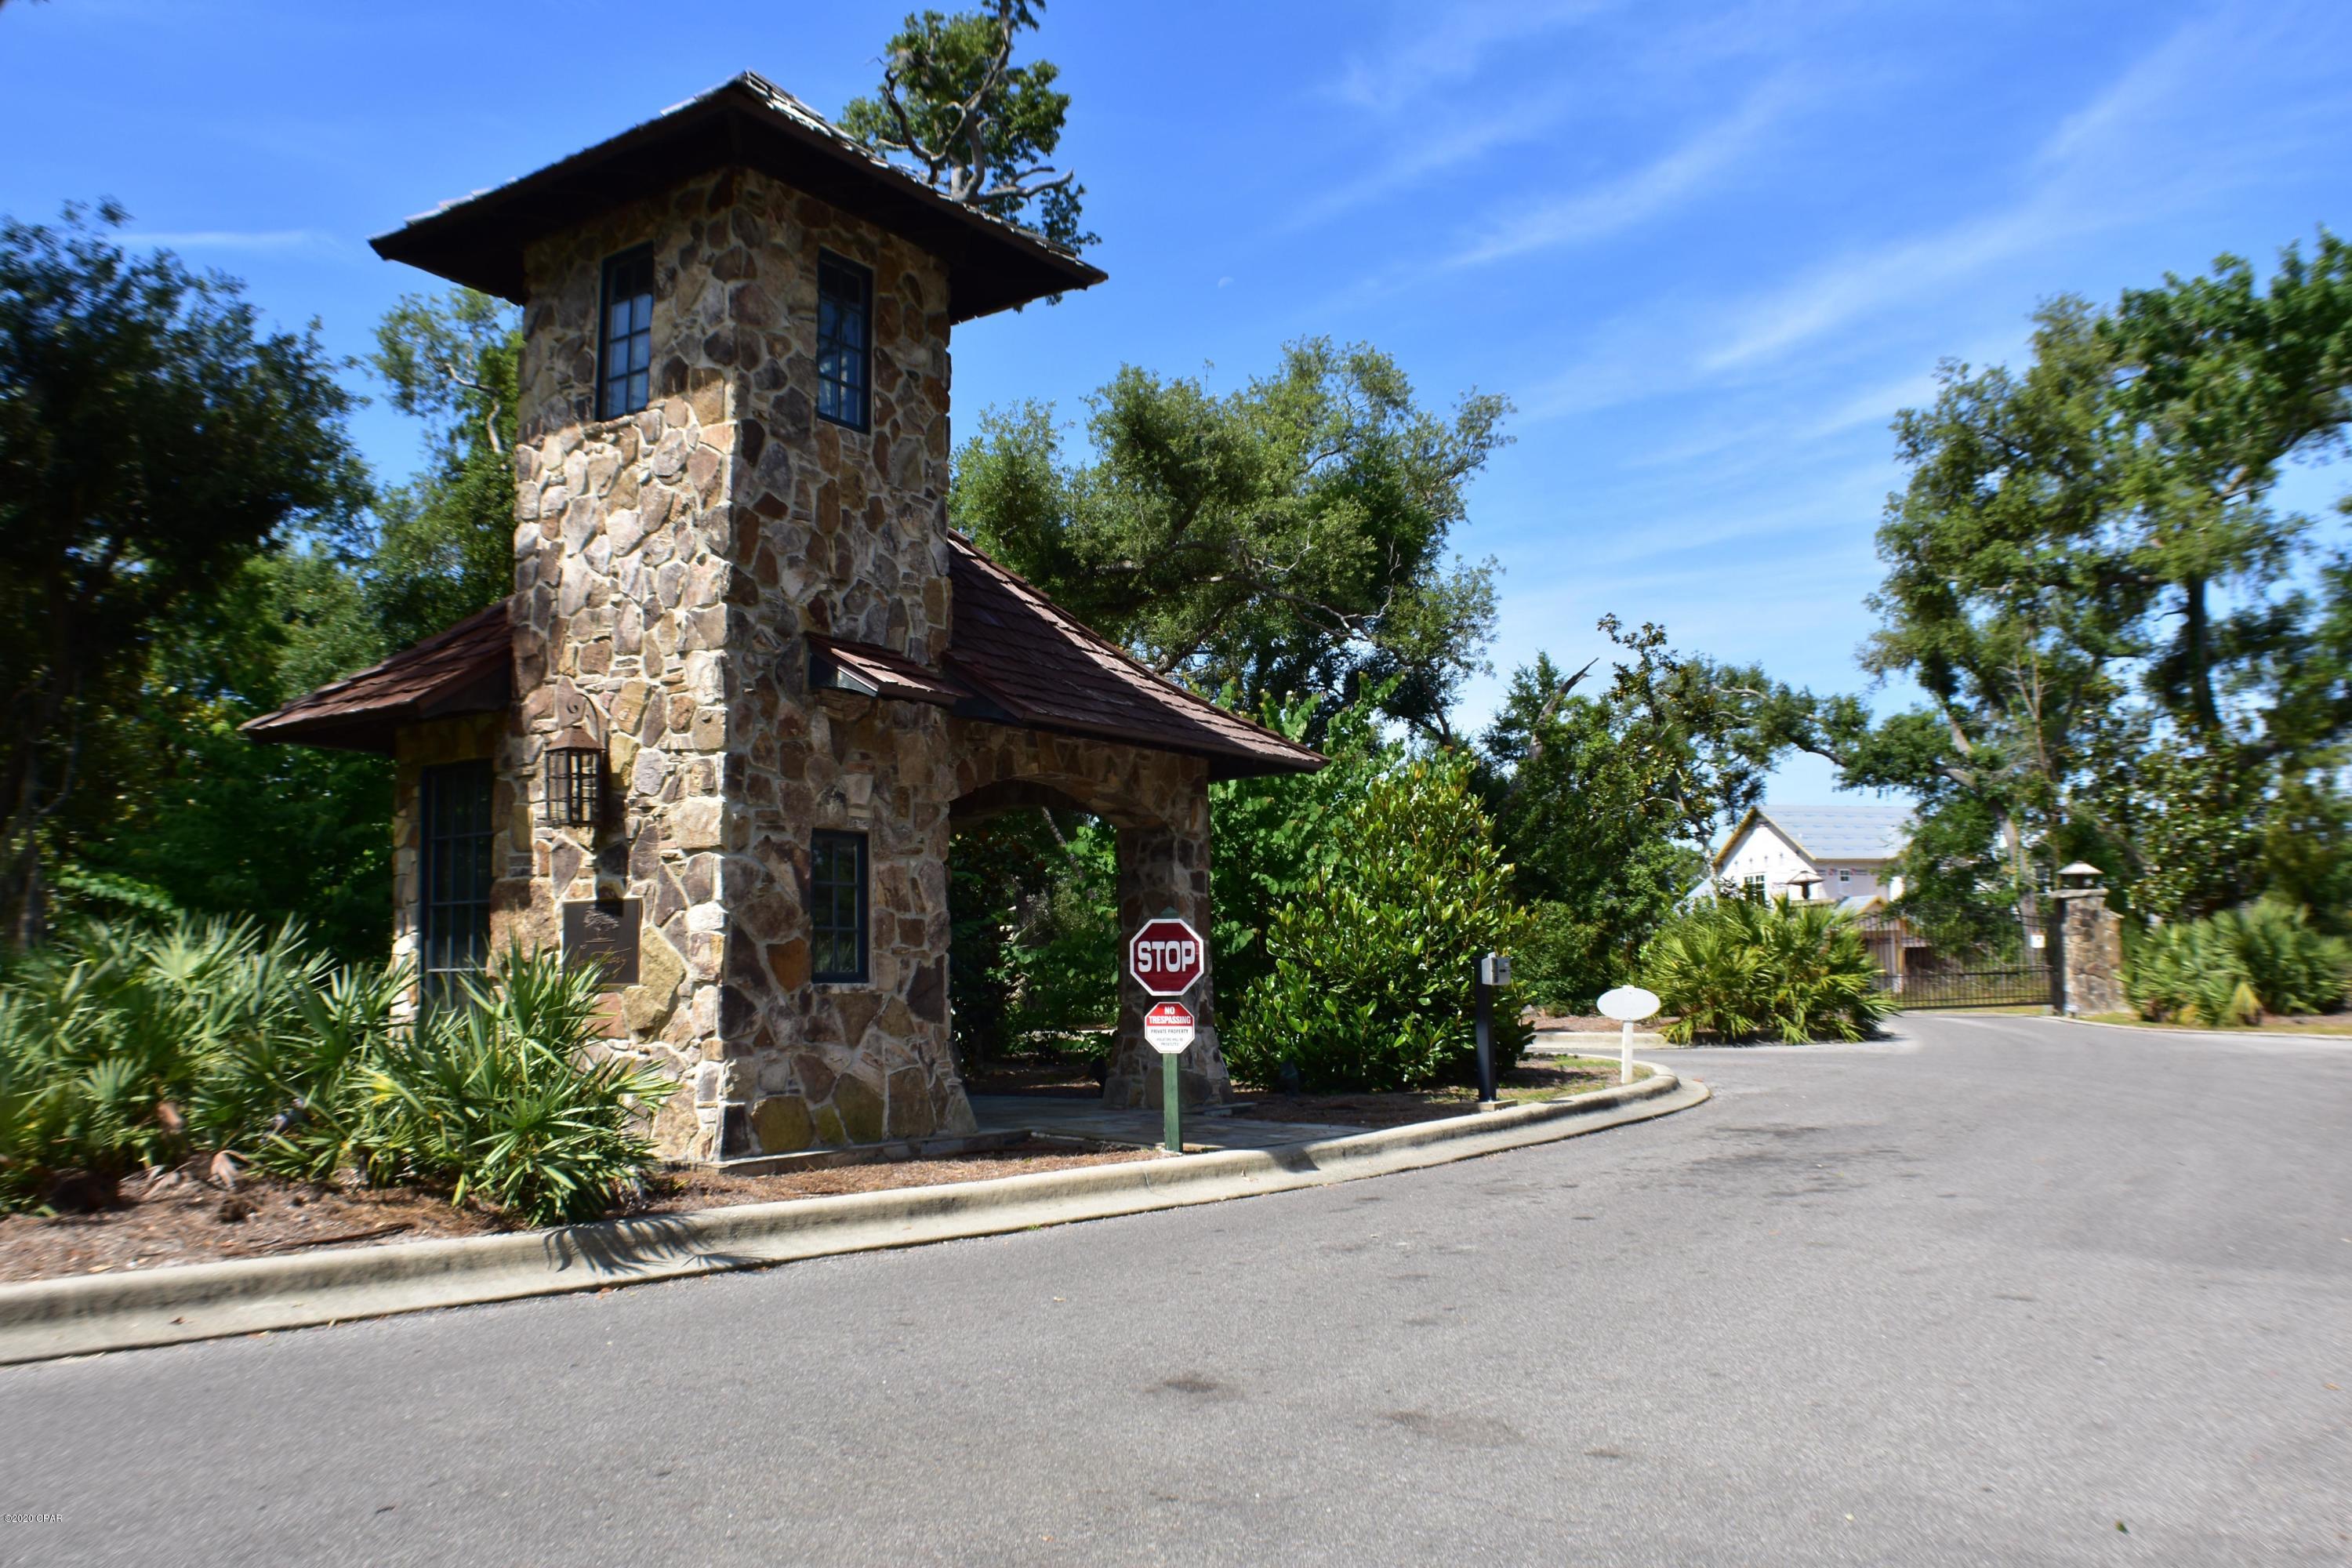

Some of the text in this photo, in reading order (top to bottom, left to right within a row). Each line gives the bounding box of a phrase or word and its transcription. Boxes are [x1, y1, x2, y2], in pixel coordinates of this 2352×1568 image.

[1138, 940, 1196, 973] STOP
[1164, 1006, 1175, 1014] NO
[1149, 1015, 1191, 1024] TRESPASSING
